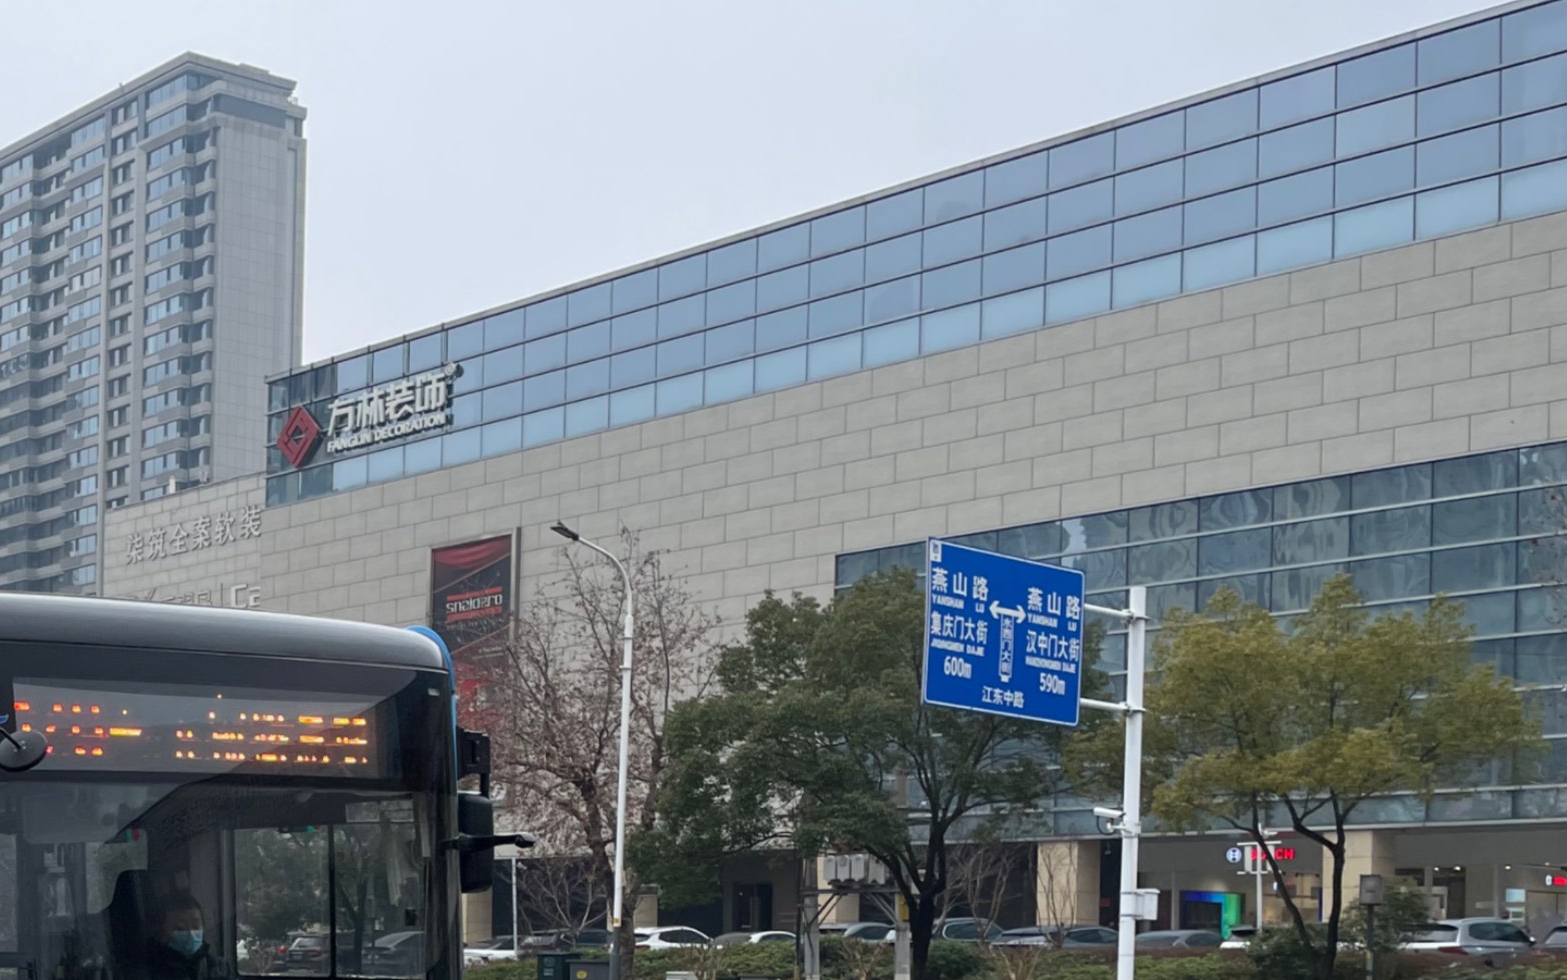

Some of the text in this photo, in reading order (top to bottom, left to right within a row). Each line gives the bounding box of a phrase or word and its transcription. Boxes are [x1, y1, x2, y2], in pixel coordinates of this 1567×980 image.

[327, 371, 447, 436] 方林装饰
[327, 411, 446, 453] FANGLIN DECORATION
[931, 566, 989, 602] 燕山路
[1027, 586, 1081, 620] 燕山路
[930, 610, 988, 646] 集庆门大街
[1025, 629, 1080, 662] 汉中门大街
[943, 655, 972, 679] 600m
[1039, 671, 1066, 696] 590m
[981, 684, 1025, 709] 江东中路
